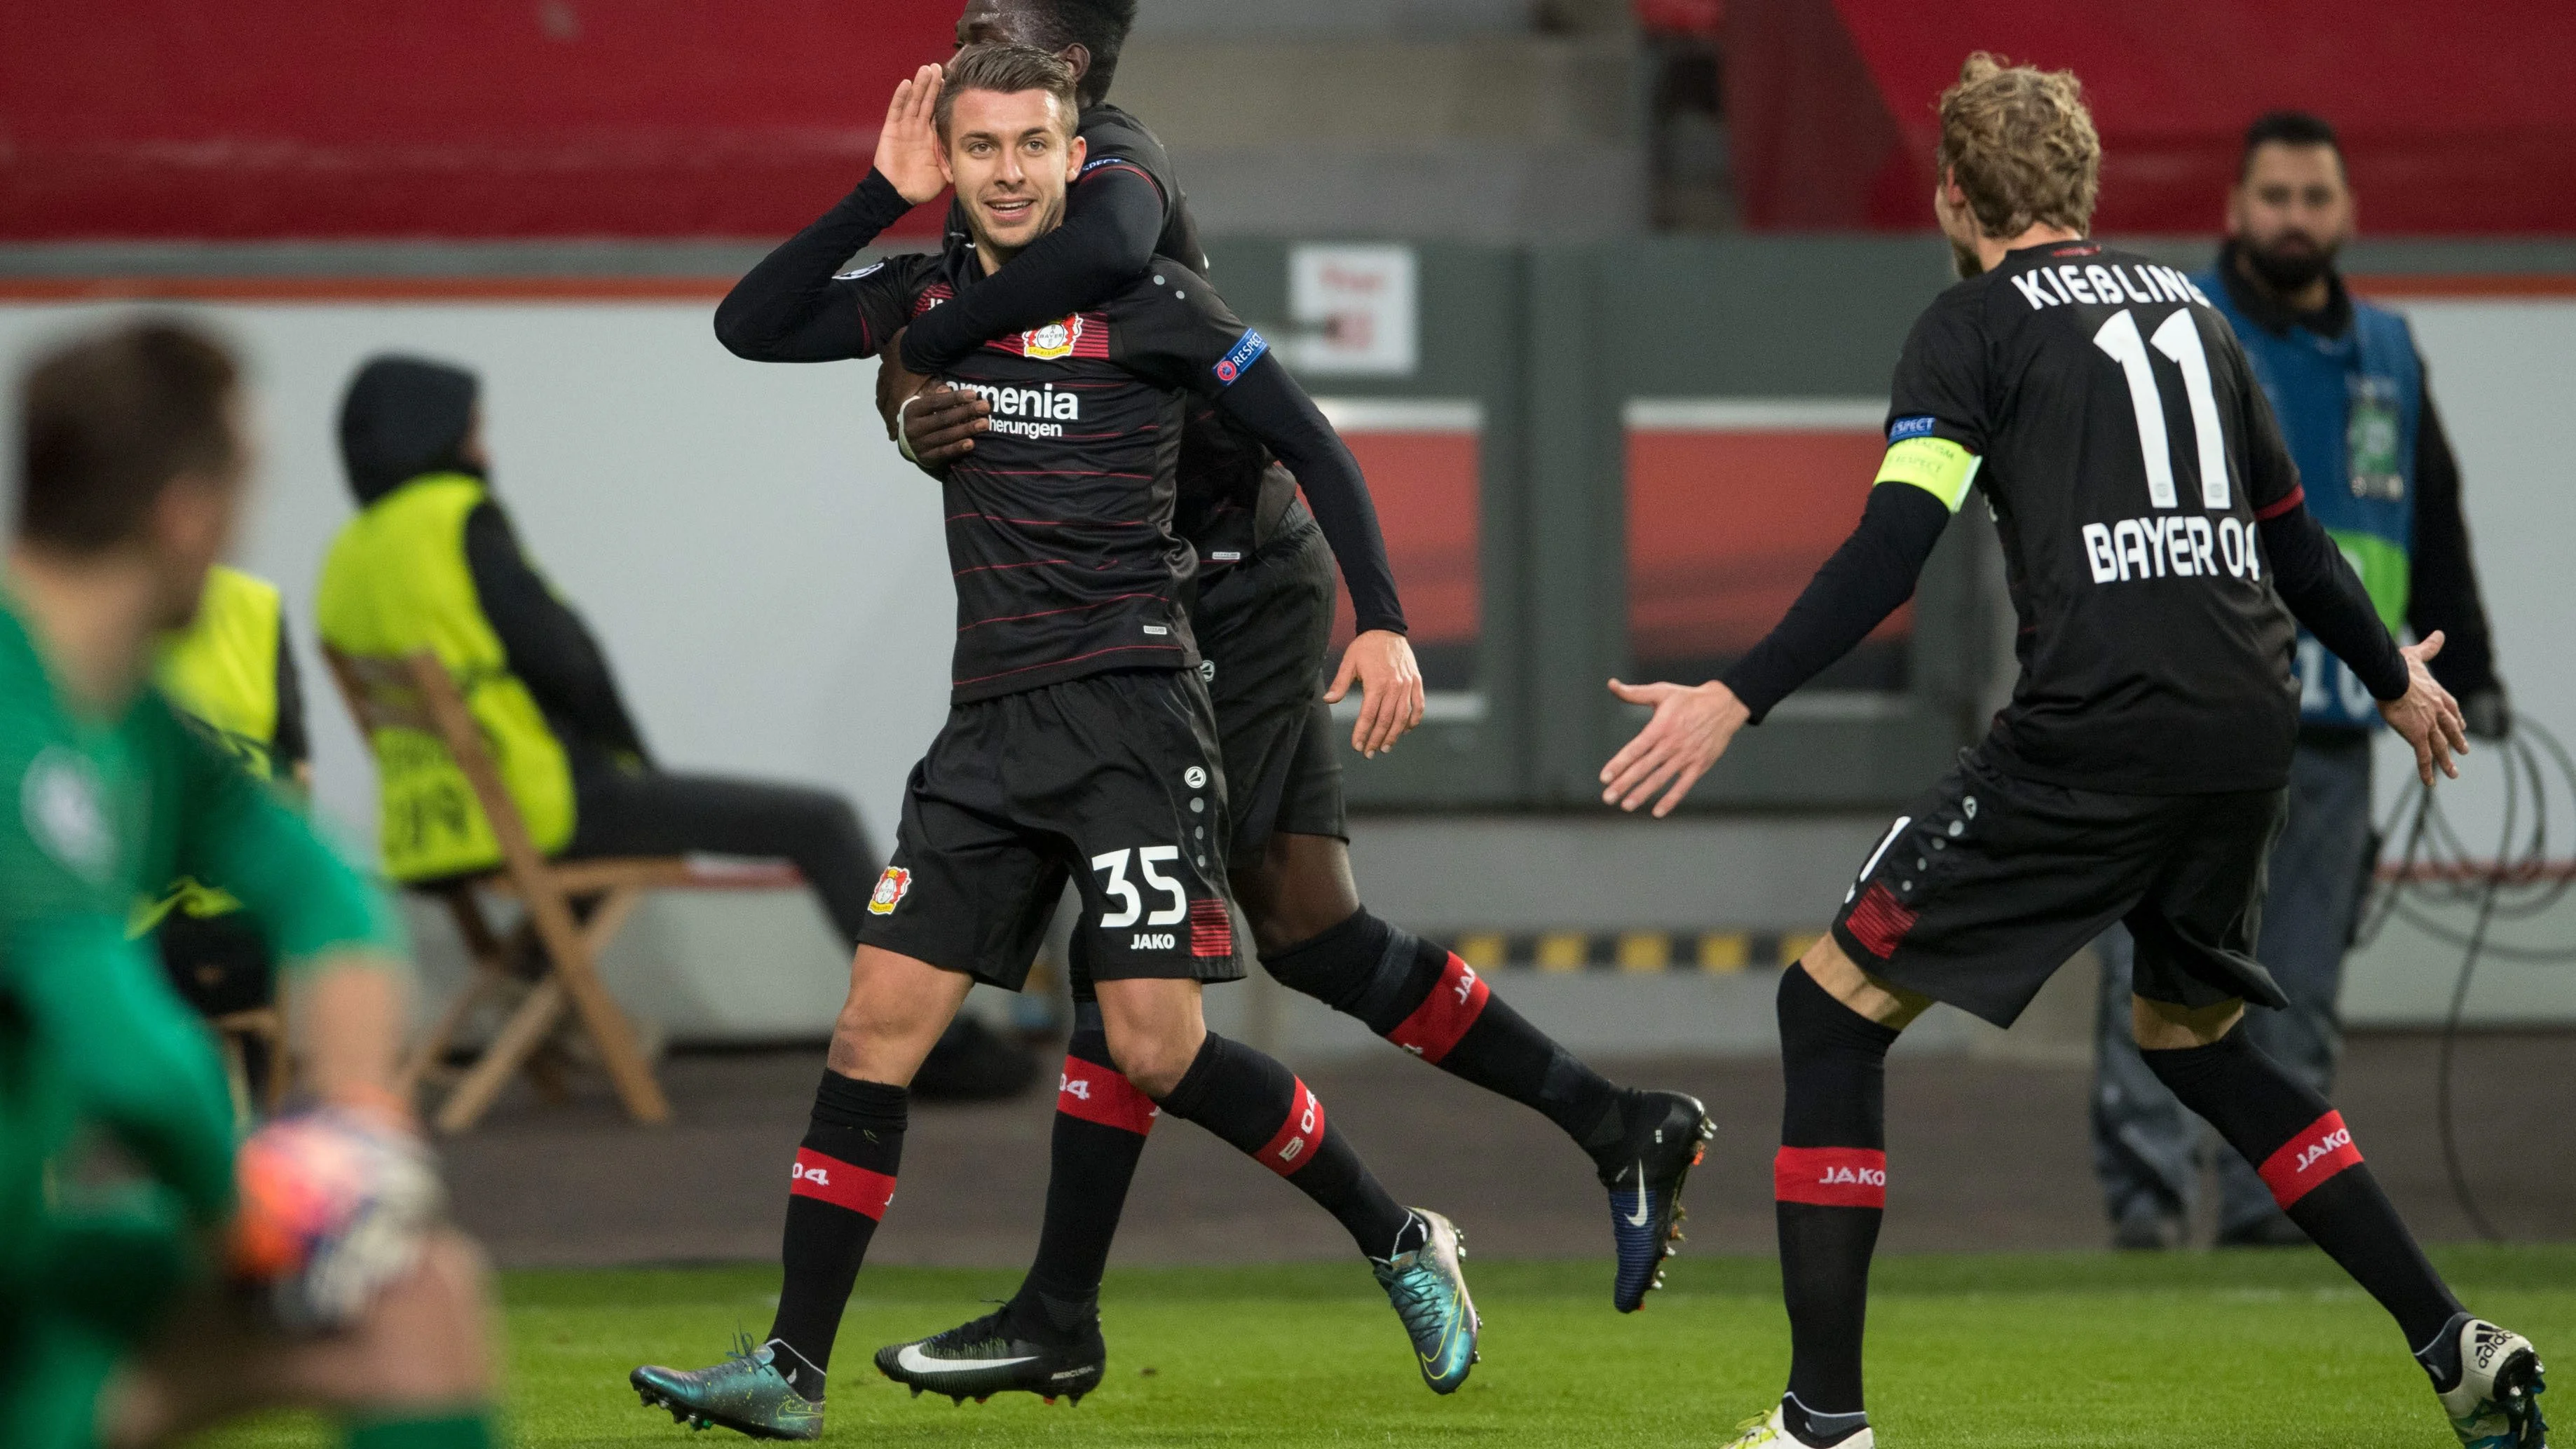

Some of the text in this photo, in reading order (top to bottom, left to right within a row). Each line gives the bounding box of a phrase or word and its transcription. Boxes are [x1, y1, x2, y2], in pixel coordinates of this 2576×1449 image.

[1232, 332, 1263, 366] RESPECT
[946, 381, 1078, 420] menia
[2093, 308, 2231, 509] 11
[2082, 516, 2261, 583] BAYER 04
[1091, 845, 1187, 927] 35
[1130, 934, 1175, 949] JAKO
[1059, 1073, 1091, 1100] 04
[2296, 1127, 2351, 1173] JAKO
[792, 1162, 830, 1185] 04
[1818, 1166, 1886, 1186] JAKO
